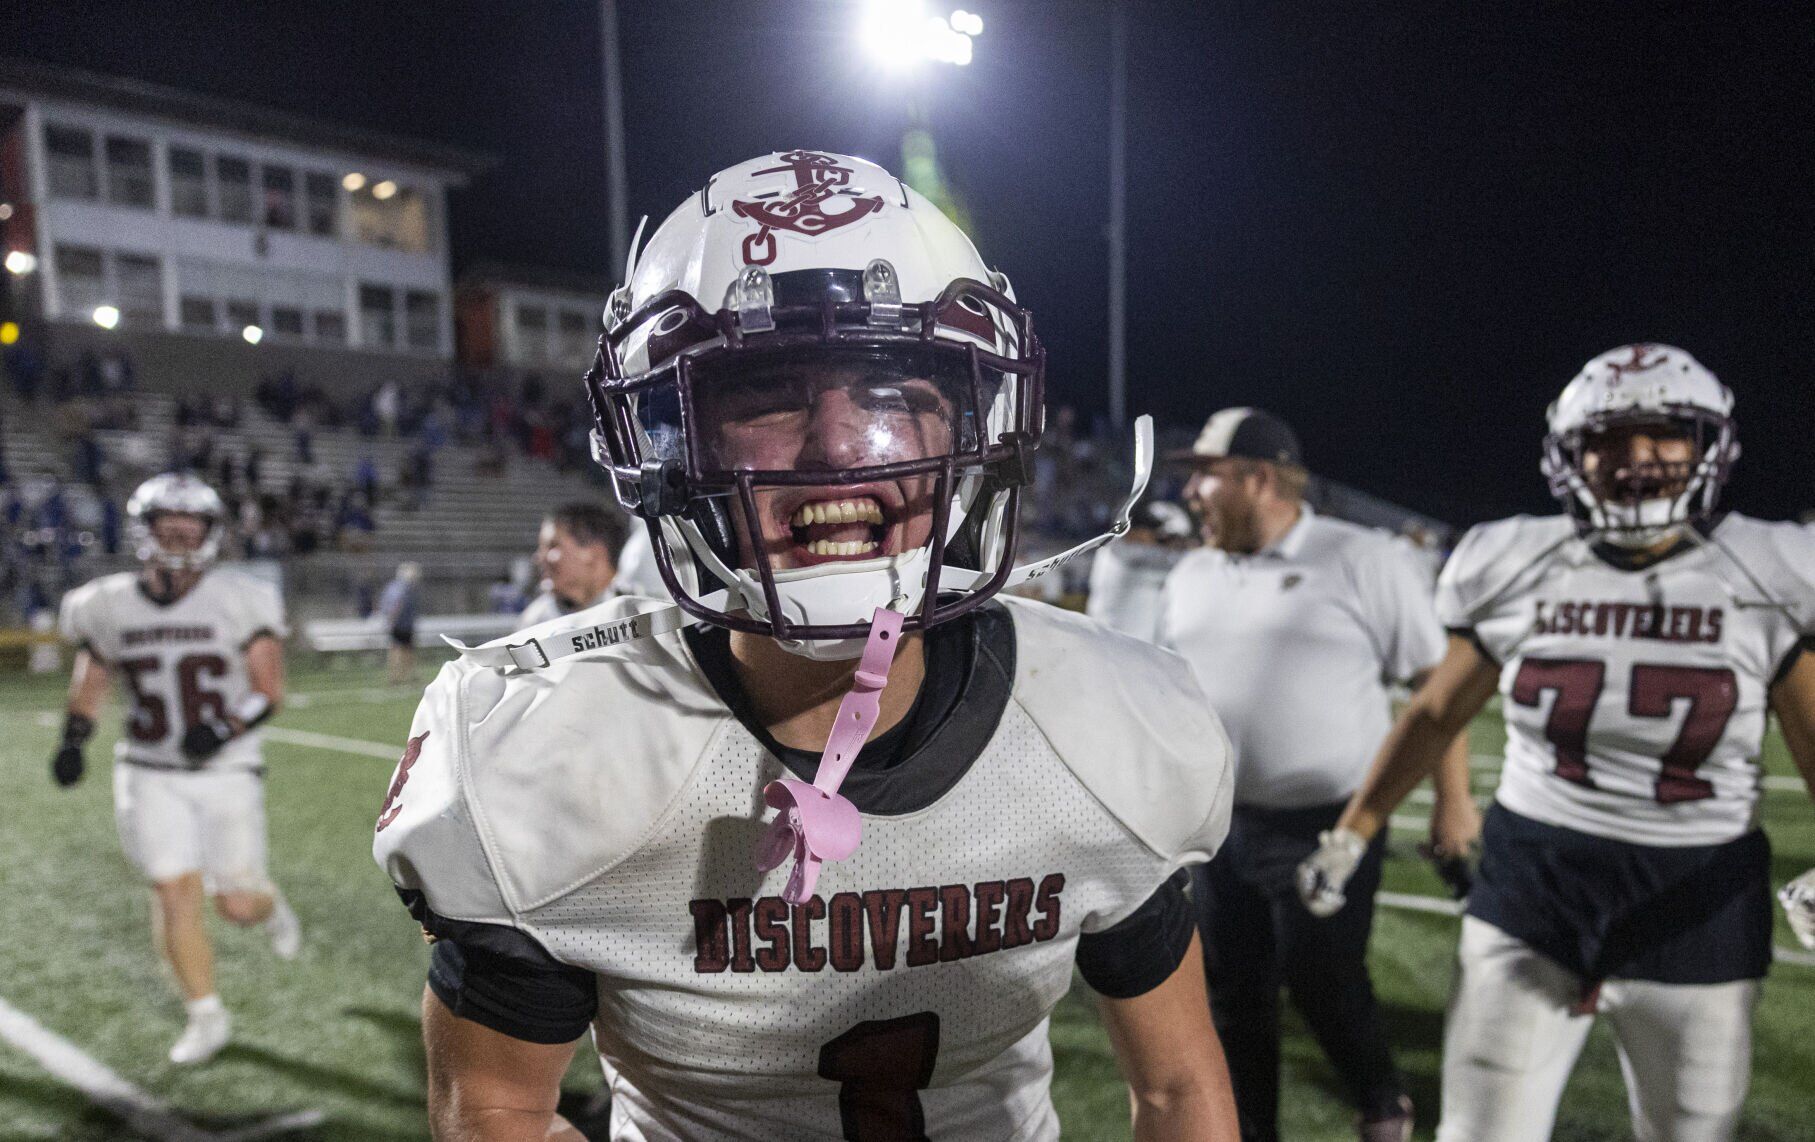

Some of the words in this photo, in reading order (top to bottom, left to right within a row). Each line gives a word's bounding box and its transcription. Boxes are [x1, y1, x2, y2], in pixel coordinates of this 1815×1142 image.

[571, 619, 641, 653] schutt
[120, 655, 228, 743] 56
[1511, 656, 1739, 803] 77
[689, 873, 1066, 973] DISCOVERERS
[817, 1010, 940, 1142] 1
